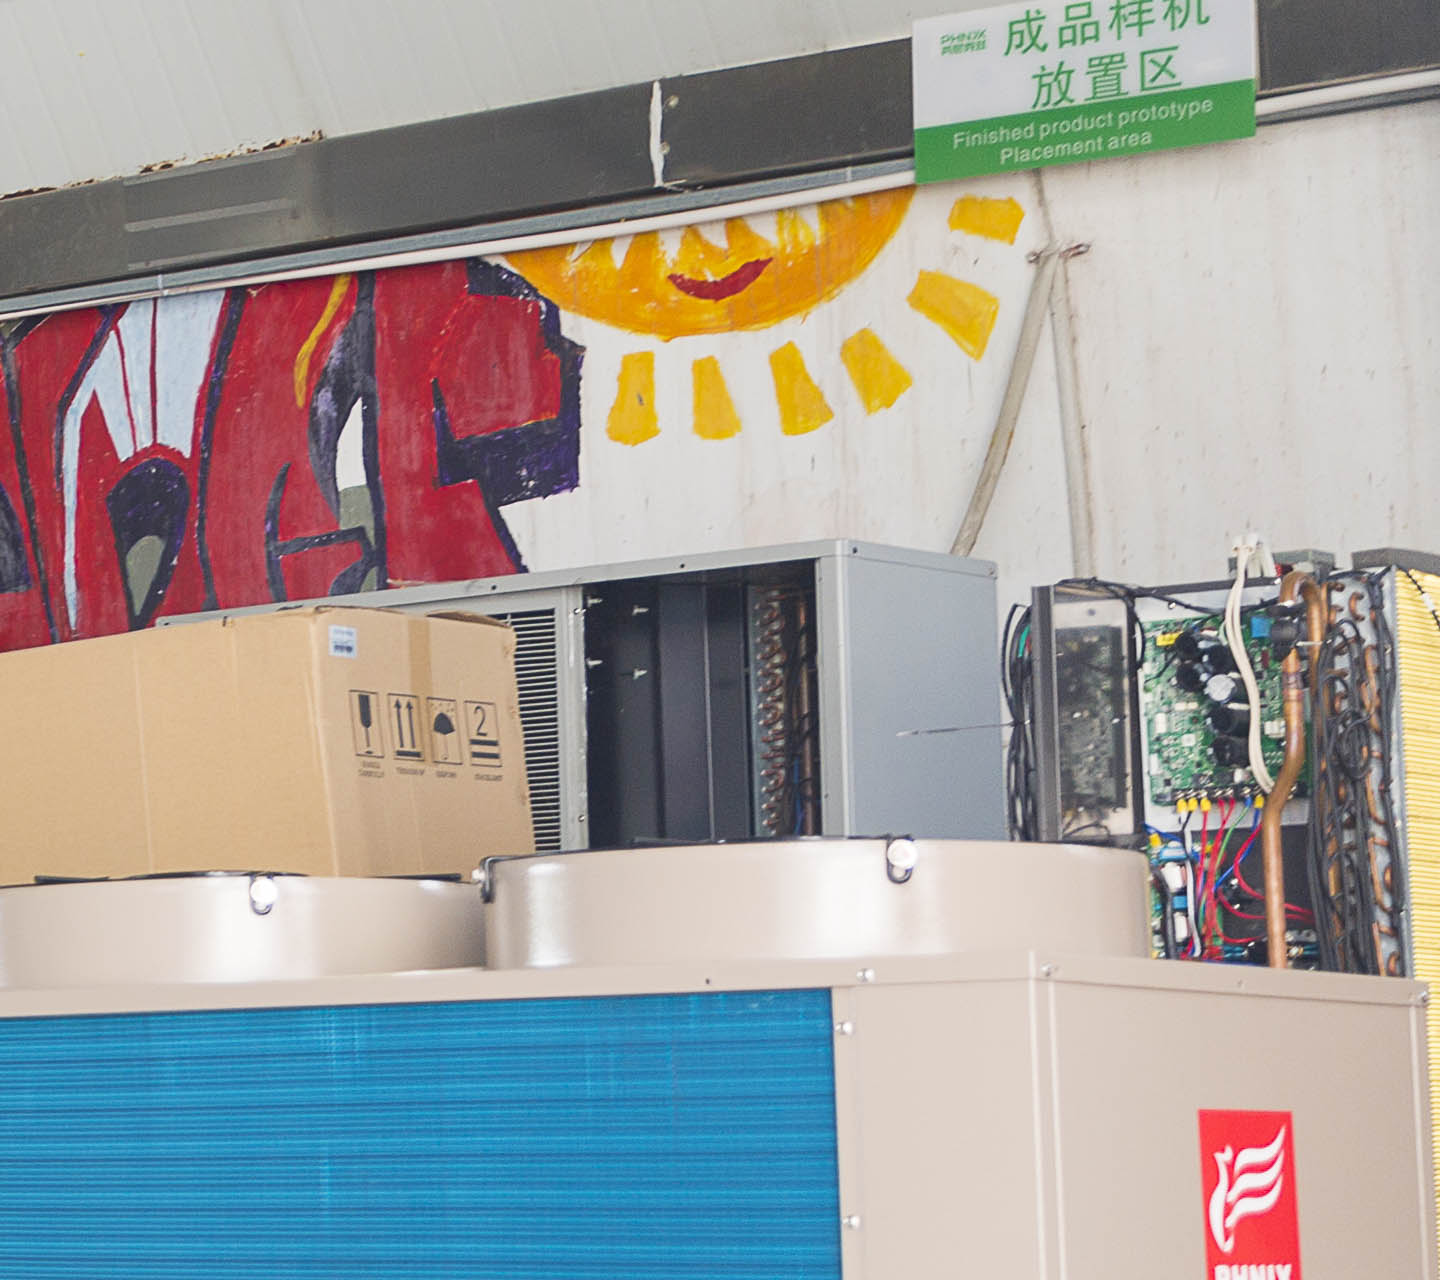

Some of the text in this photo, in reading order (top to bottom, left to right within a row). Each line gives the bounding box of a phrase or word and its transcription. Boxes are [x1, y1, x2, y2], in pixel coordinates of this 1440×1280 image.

[1031, 45, 1183, 110] 放置区
[953, 98, 1214, 150] Finished product prototype
[1000, 131, 1153, 165] Placement area
